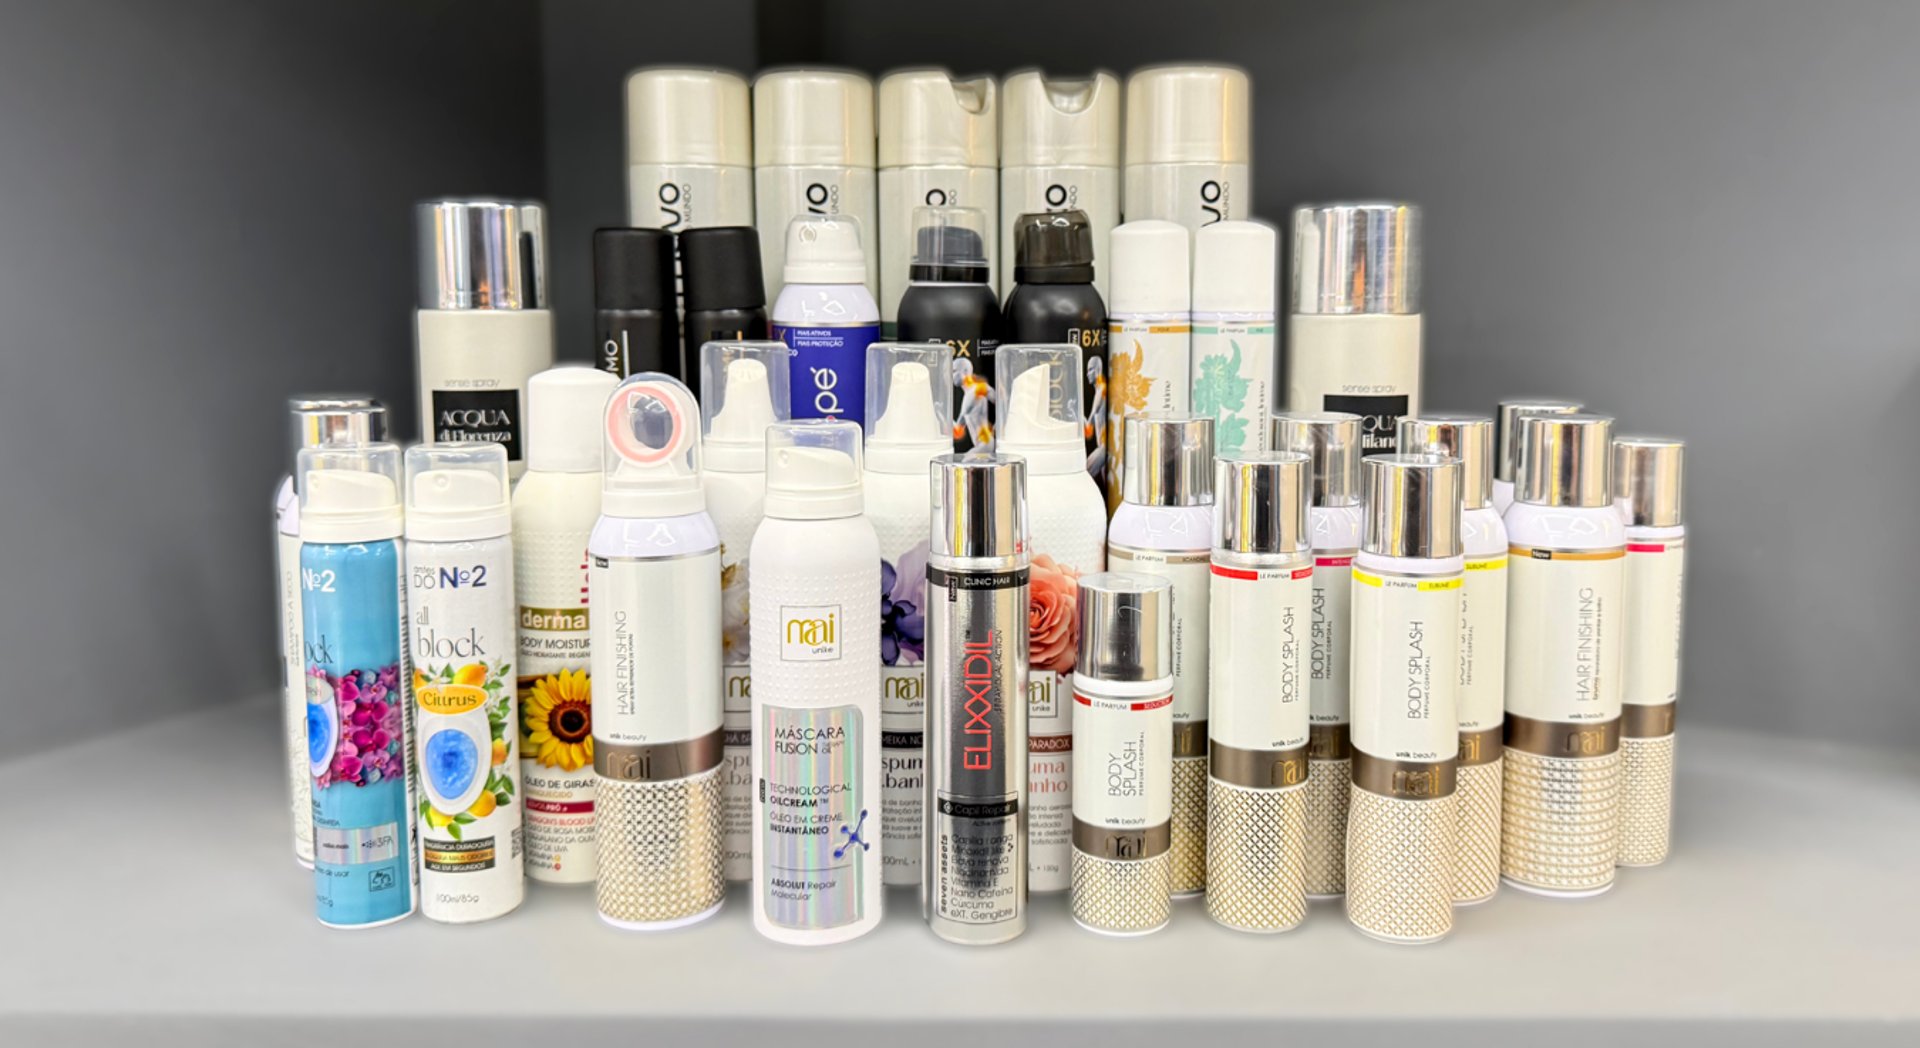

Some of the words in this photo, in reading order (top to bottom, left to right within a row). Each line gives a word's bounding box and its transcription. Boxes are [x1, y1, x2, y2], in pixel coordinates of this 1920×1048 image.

[659, 182, 682, 231] VO
[830, 184, 839, 214] UNDO
[1082, 329, 1101, 347] 6X
[604, 340, 618, 375] MO
[440, 409, 511, 428] ACQUA
[1533, 550, 1550, 558] New
[413, 574, 436, 589] DO
[416, 606, 429, 626] all
[1311, 587, 1325, 639] SPLASH
[1577, 587, 1594, 663] FINISHING
[417, 627, 486, 659] block
[787, 613, 835, 646] mai
[1282, 606, 1295, 662] SPLASH
[614, 610, 628, 679] FINISHING
[1408, 620, 1424, 675] SPLASH
[1311, 641, 1324, 680] BODY
[1029, 676, 1052, 704] ai
[1282, 663, 1293, 703] BODY
[1576, 665, 1592, 701] HAIR
[423, 692, 477, 707] Citrus
[616, 682, 629, 715] HAIR
[963, 629, 993, 770] ELIXXIDIL
[1408, 680, 1422, 720] BODY
[774, 725, 845, 741] MÁSCARA
[774, 741, 818, 755] FUSION
[1108, 752, 1122, 797] BODY
[1122, 741, 1137, 797] SPLASH
[548, 780, 560, 789] DE
[563, 779, 595, 789] GIRAS
[770, 782, 852, 796] TECHNOLOGICAL
[769, 795, 818, 808] OILCREAM
[769, 823, 829, 836] INSTANTÂNEO
[794, 815, 808, 824] EM
[771, 878, 805, 890] ABSOLUT
[807, 879, 837, 891] Repair
[771, 889, 811, 901] Molecular
[951, 887, 976, 898] Nano
[993, 878, 999, 887] E
[970, 908, 1014, 921] Gengibre
